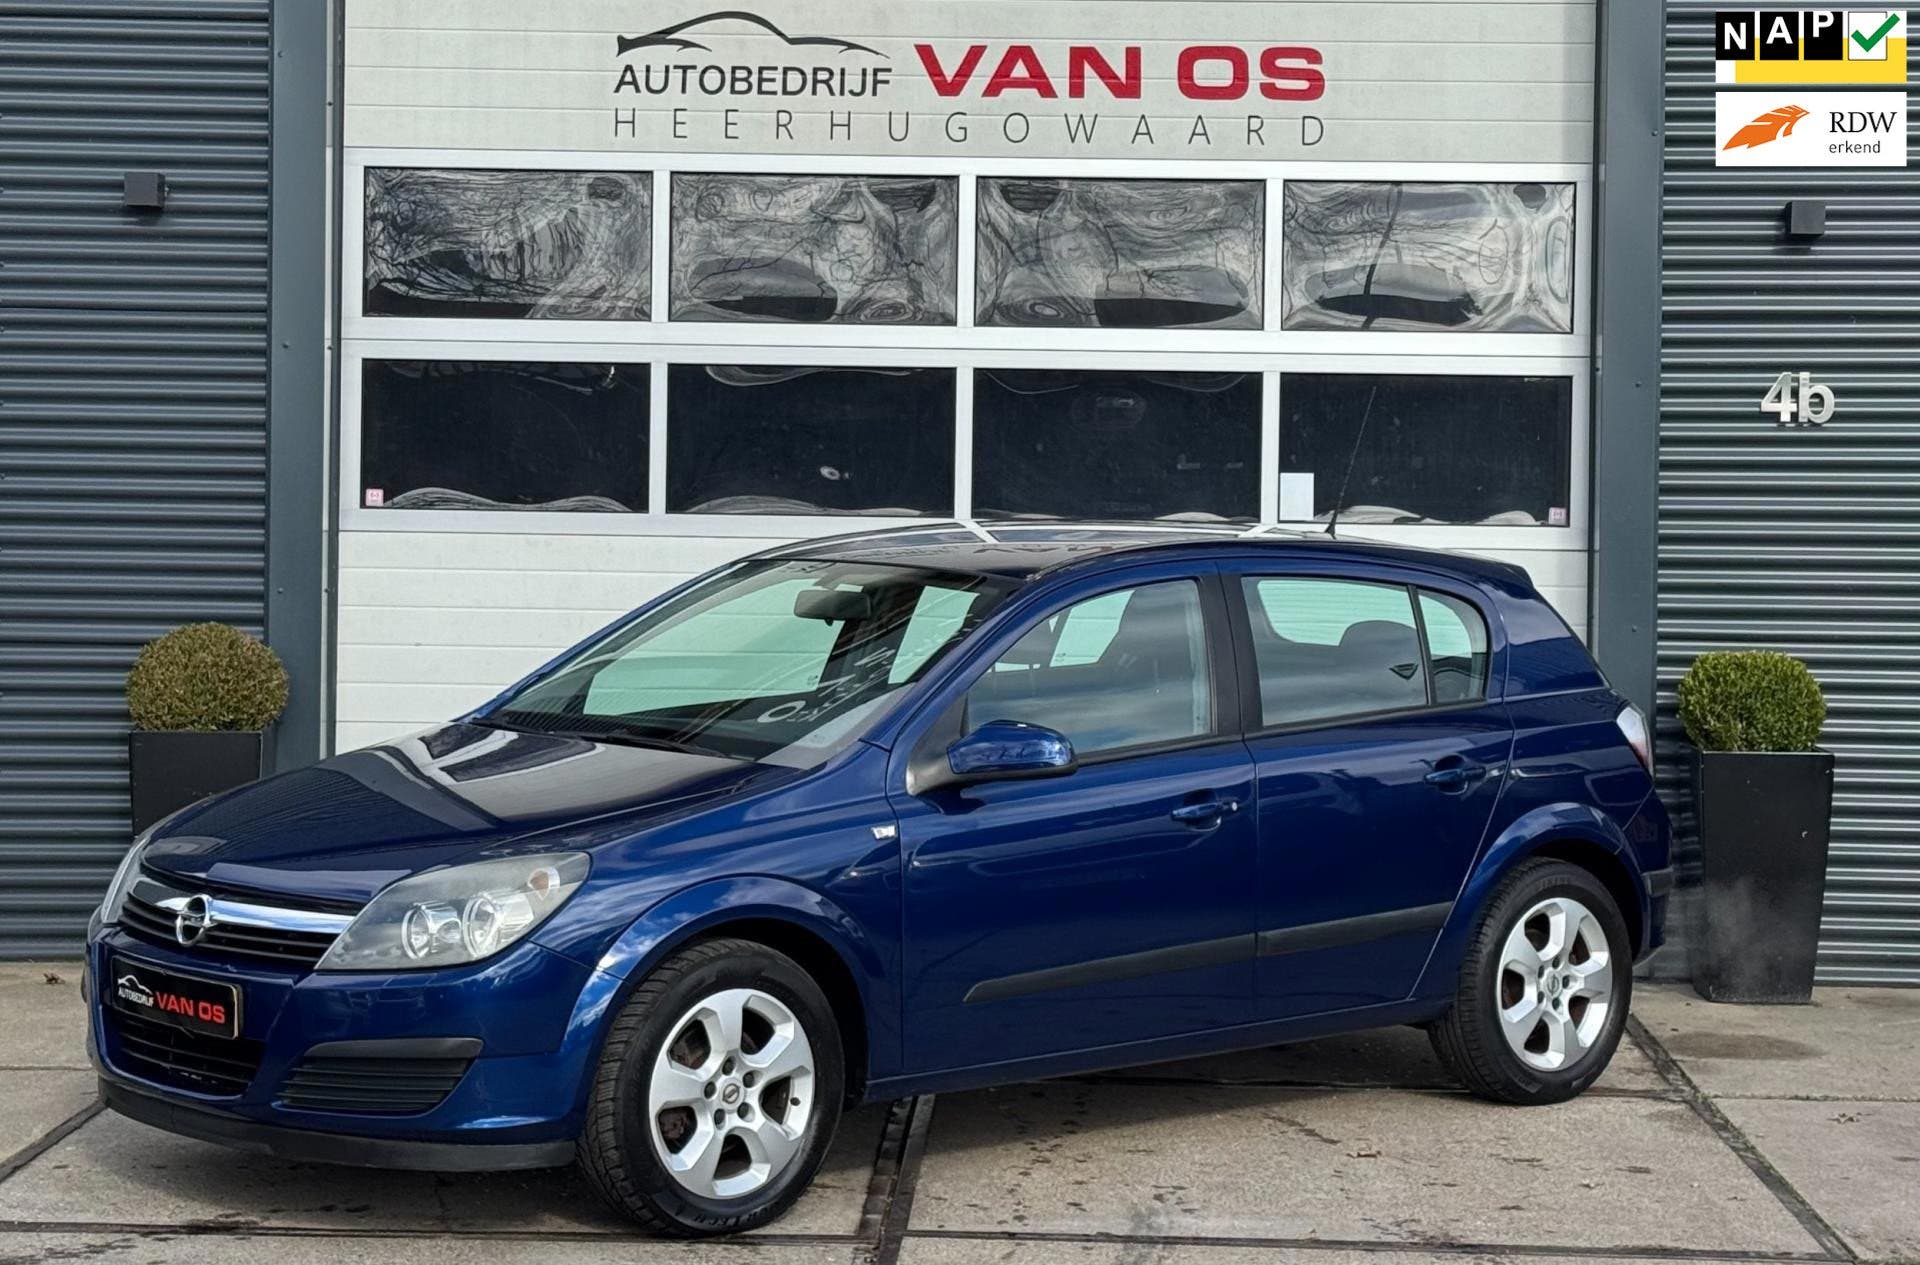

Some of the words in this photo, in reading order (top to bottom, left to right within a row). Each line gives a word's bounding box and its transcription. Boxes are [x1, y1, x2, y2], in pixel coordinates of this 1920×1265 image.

[614, 64, 893, 97] AUTOBEDRIJF
[914, 44, 1142, 99] VAN
[1177, 46, 1326, 101] OS
[613, 107, 1325, 146] HEERHUGOWAARD
[1761, 372, 1834, 424] 4b
[156, 991, 194, 1016] VAN
[198, 1001, 225, 1024] OS
